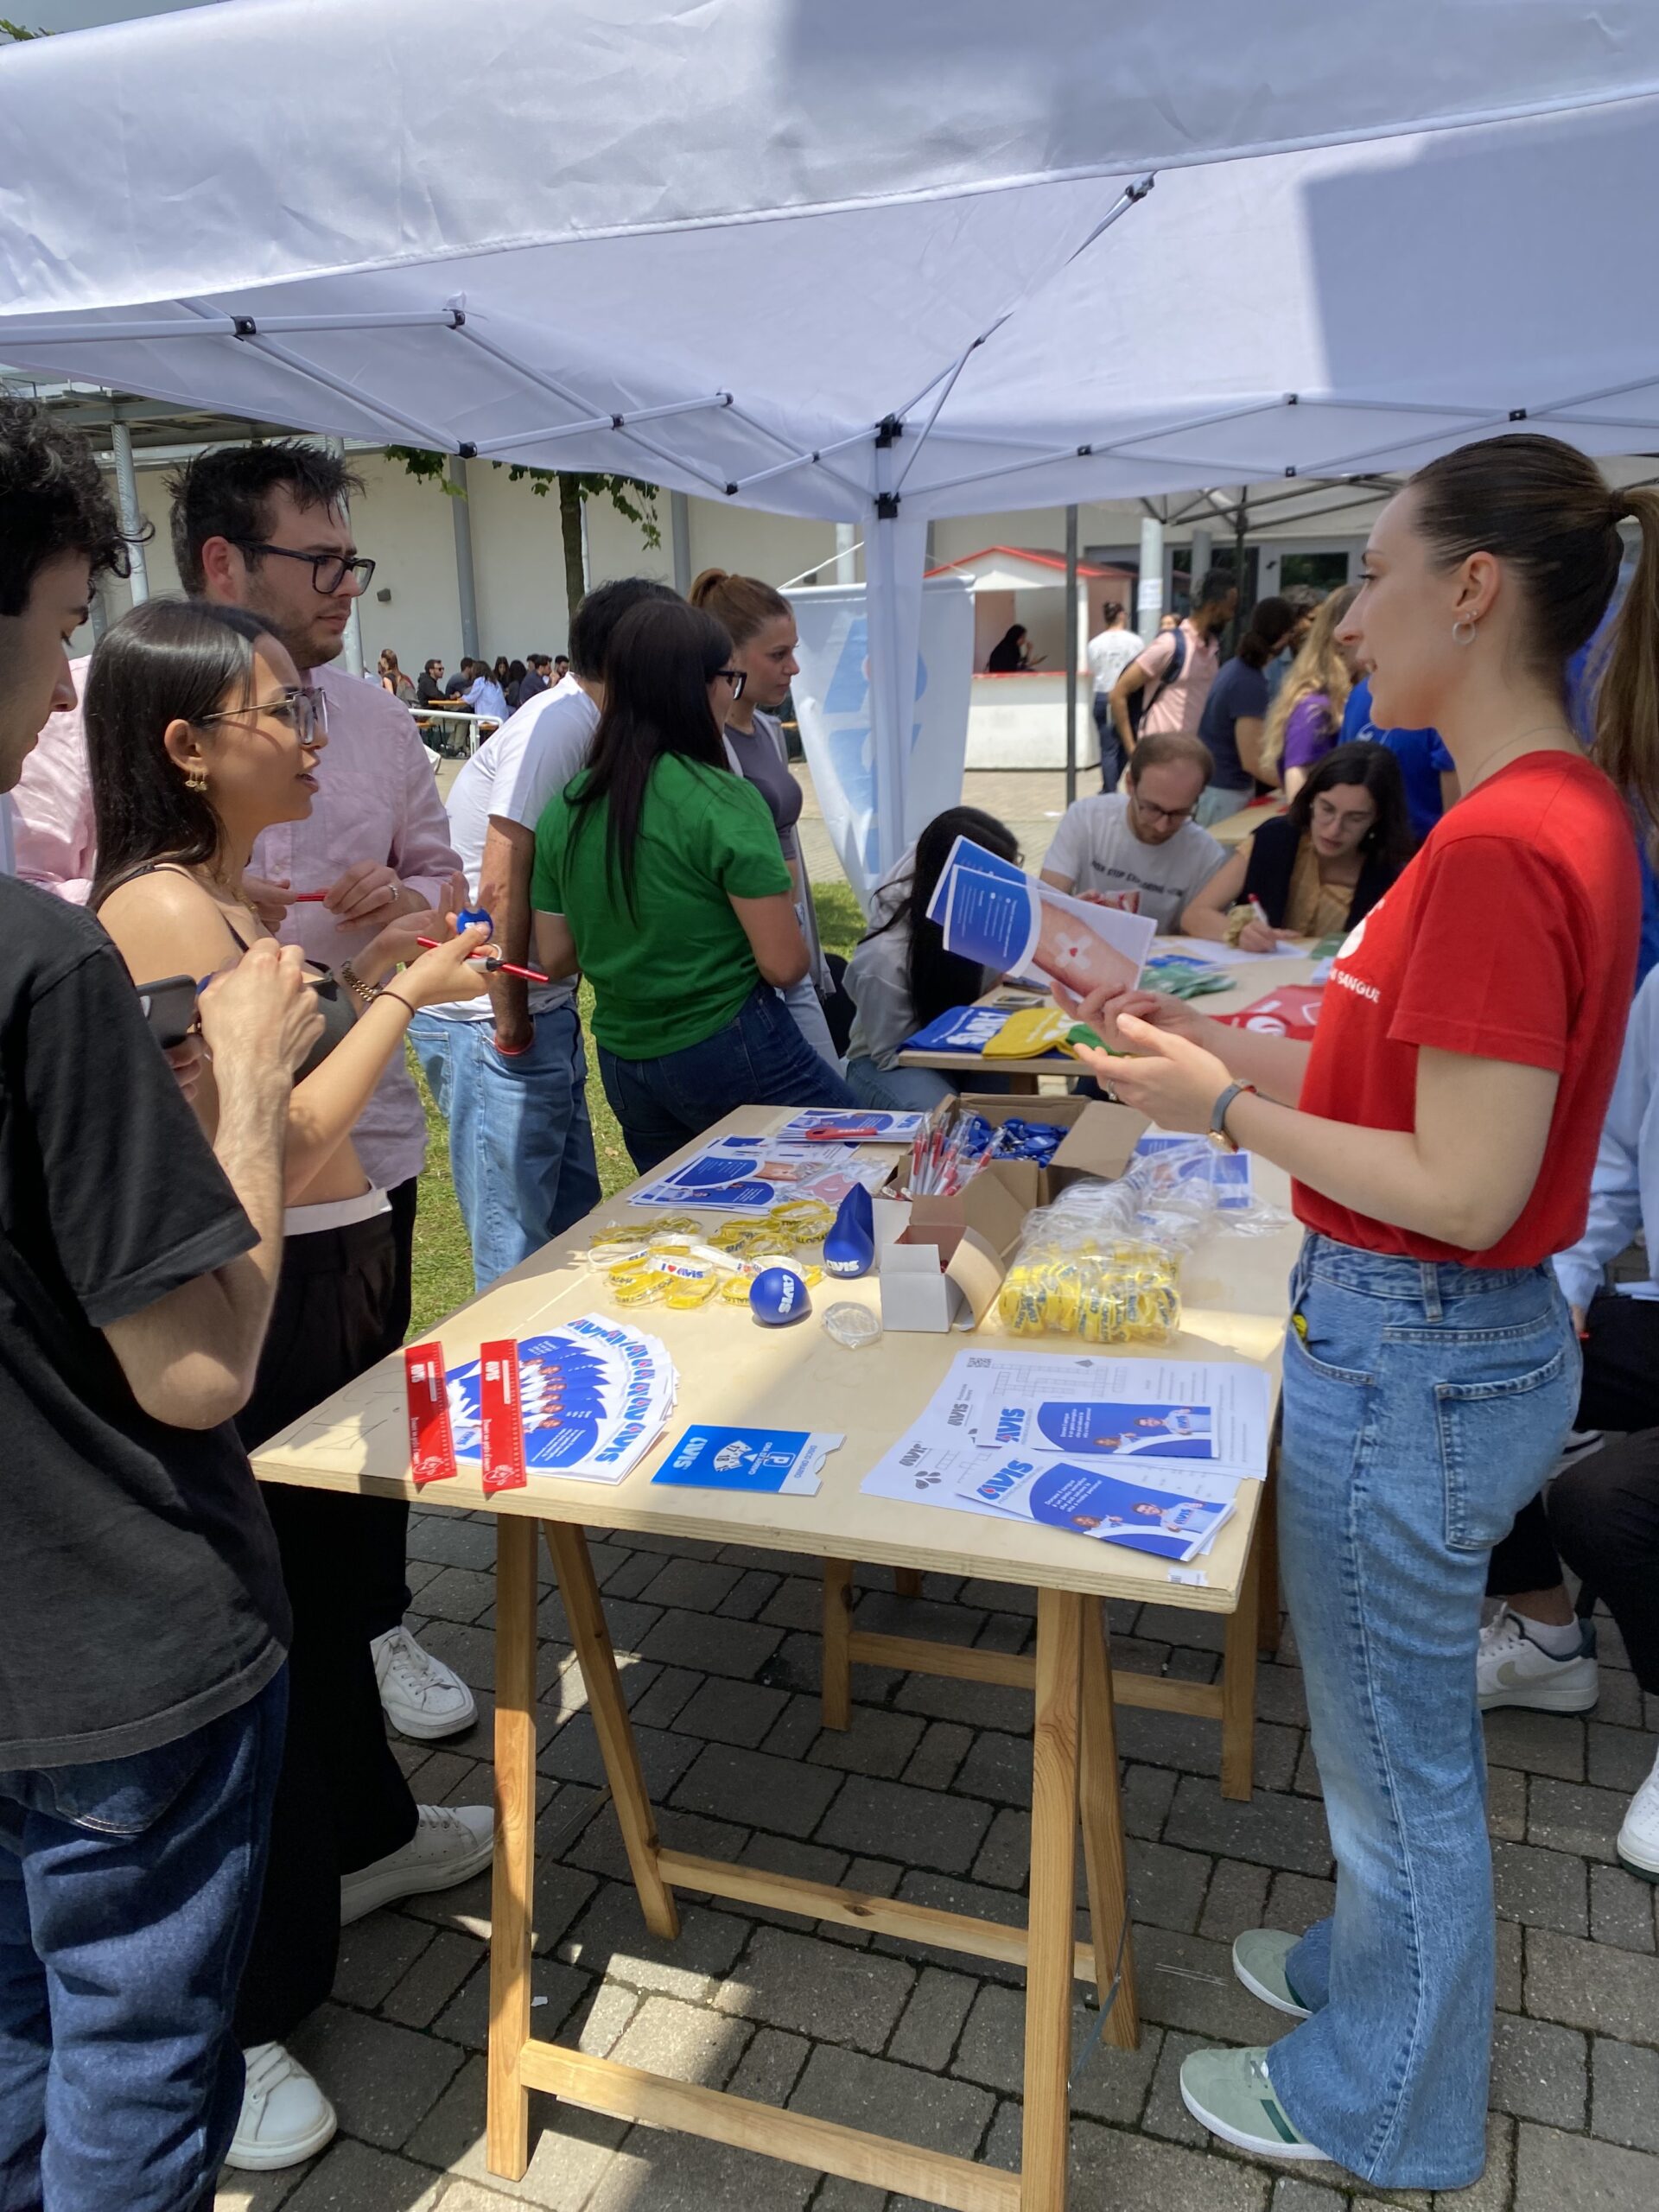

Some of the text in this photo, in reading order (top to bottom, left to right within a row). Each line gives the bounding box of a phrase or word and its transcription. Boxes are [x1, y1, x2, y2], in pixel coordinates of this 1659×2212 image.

[1338, 970, 1381, 1003] SANGUE
[825, 1260, 861, 1273] AVIS
[778, 1274, 795, 1314] AVIS
[411, 1363, 425, 1382] AVIS
[486, 1361, 500, 1381] AVIS
[947, 1402, 969, 1427] AVIS
[995, 1408, 1026, 1442] AVIS
[594, 1422, 646, 1464] AVIS
[673, 1436, 709, 1470] AVIS
[804, 1445, 817, 1459] DISCO
[976, 1458, 1033, 1501] AVIS
[1174, 1508, 1193, 1524] AVIS
